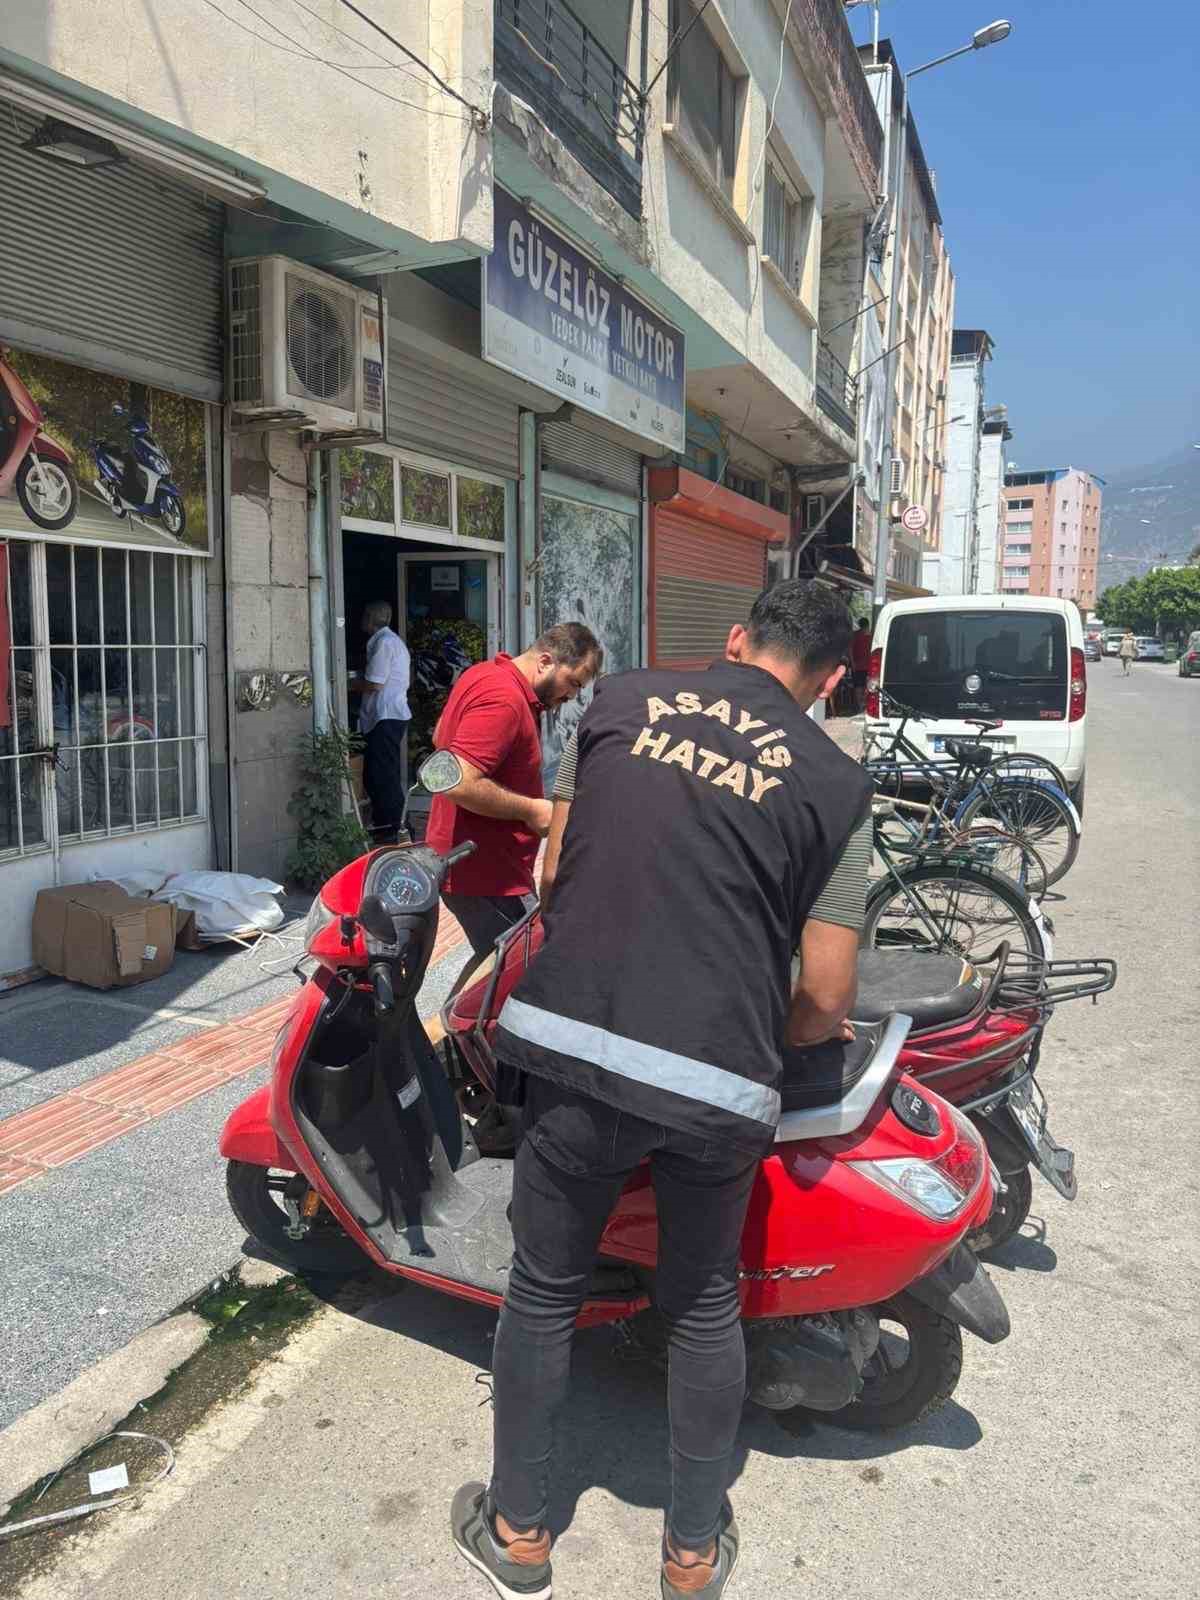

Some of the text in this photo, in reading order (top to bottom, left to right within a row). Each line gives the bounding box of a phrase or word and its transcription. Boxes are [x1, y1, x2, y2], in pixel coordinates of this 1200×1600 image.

[508, 219, 675, 381] GÜZELÖZ MOTOR
[550, 311, 580, 346] YEDEK
[630, 727, 783, 803] HATAY
[647, 691, 792, 768] ASAYİŞ
